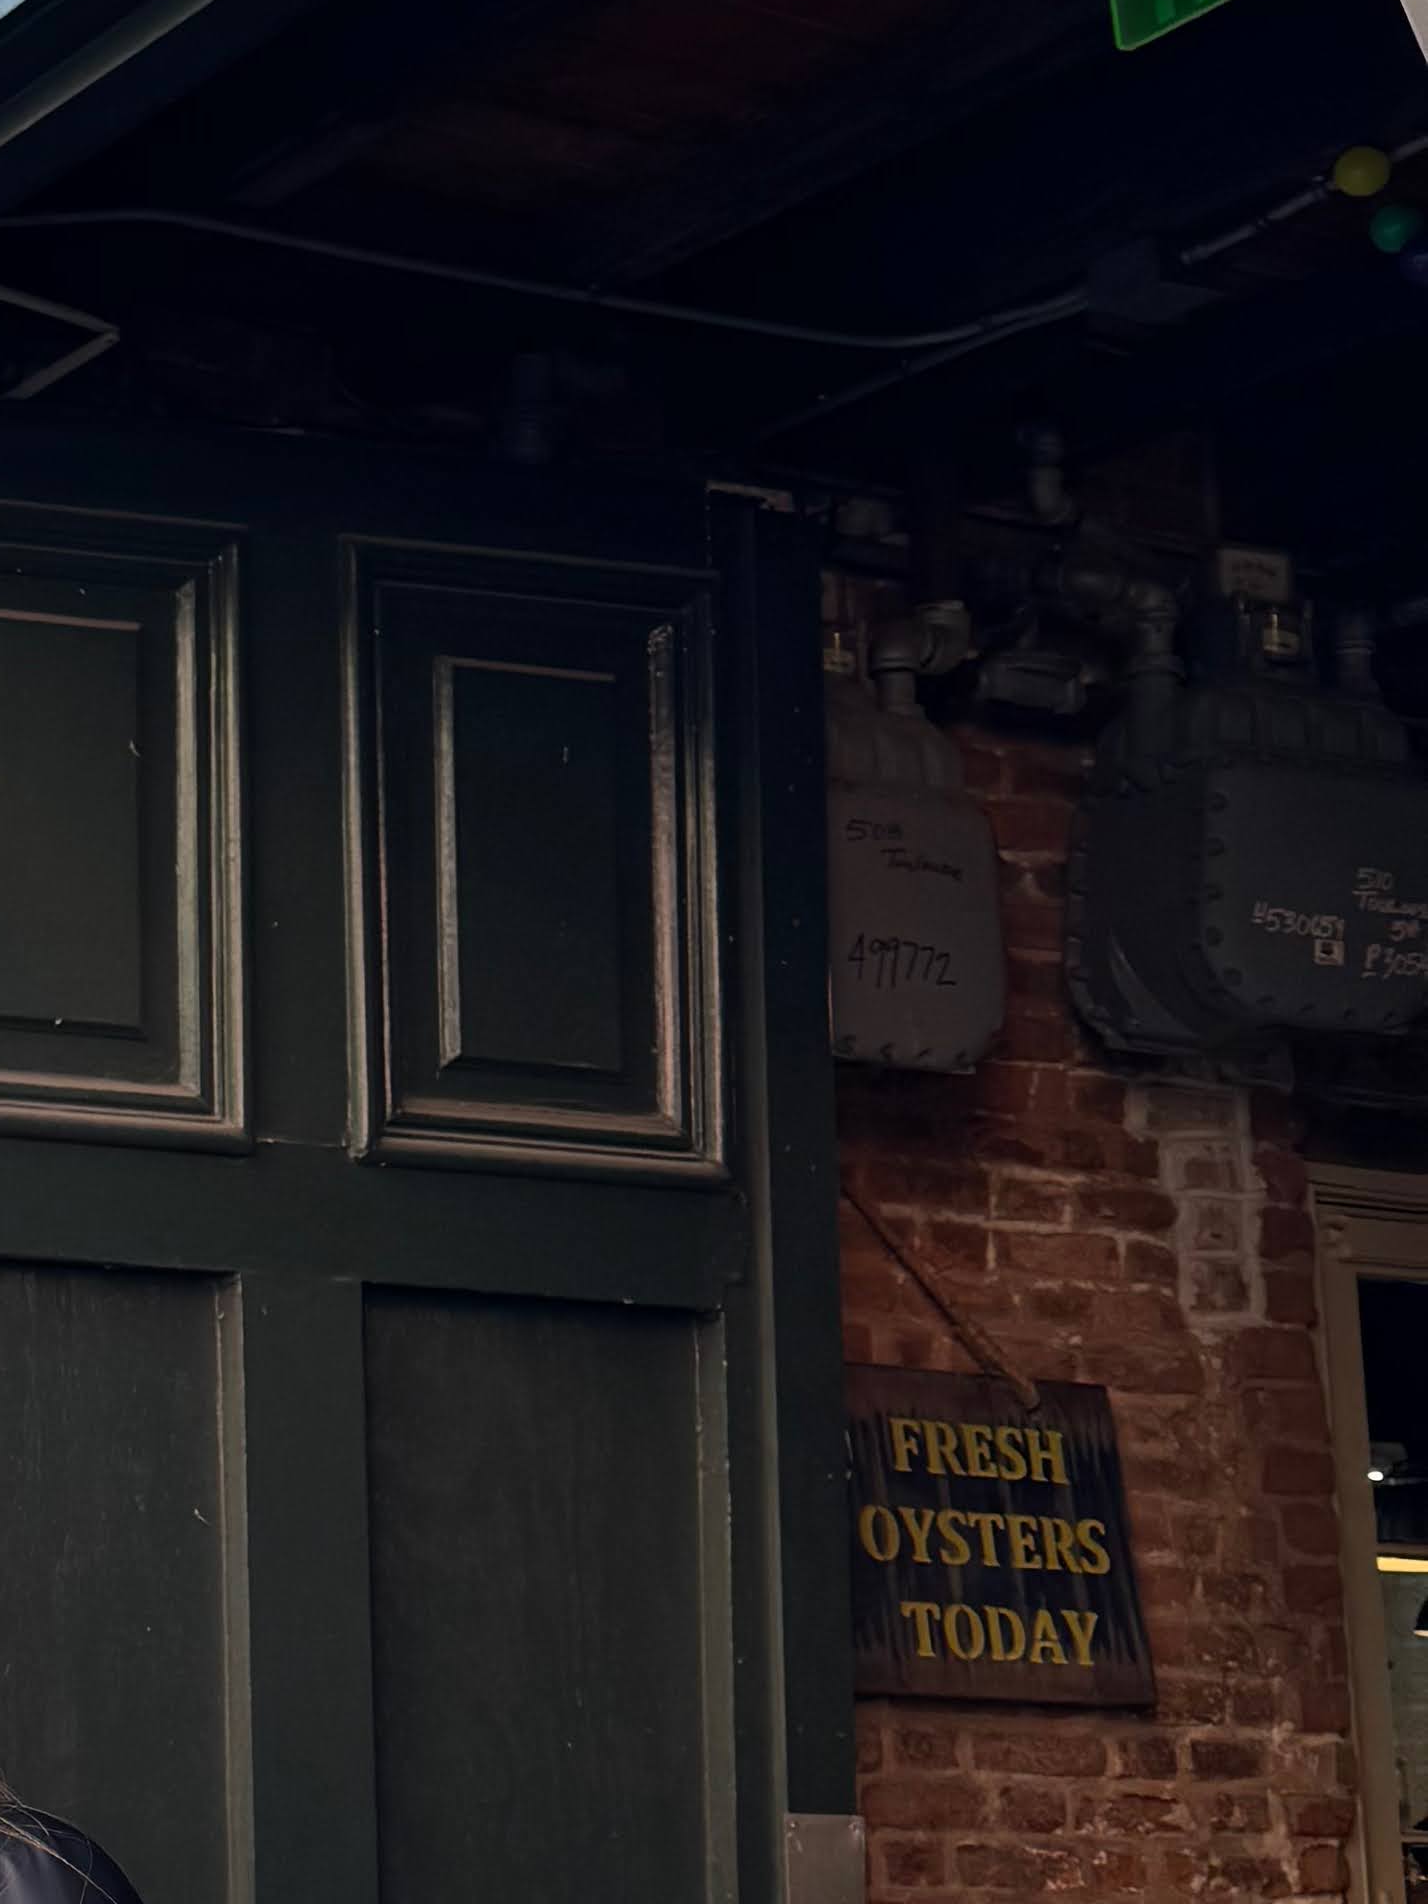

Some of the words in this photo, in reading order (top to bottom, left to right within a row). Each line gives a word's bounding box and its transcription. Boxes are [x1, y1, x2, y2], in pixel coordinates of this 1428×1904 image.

[847, 932, 958, 990] 499772
[891, 1415, 1068, 1487] FRESH
[859, 1501, 1111, 1576] OYSTERS
[899, 1597, 1101, 1668] TODAY
